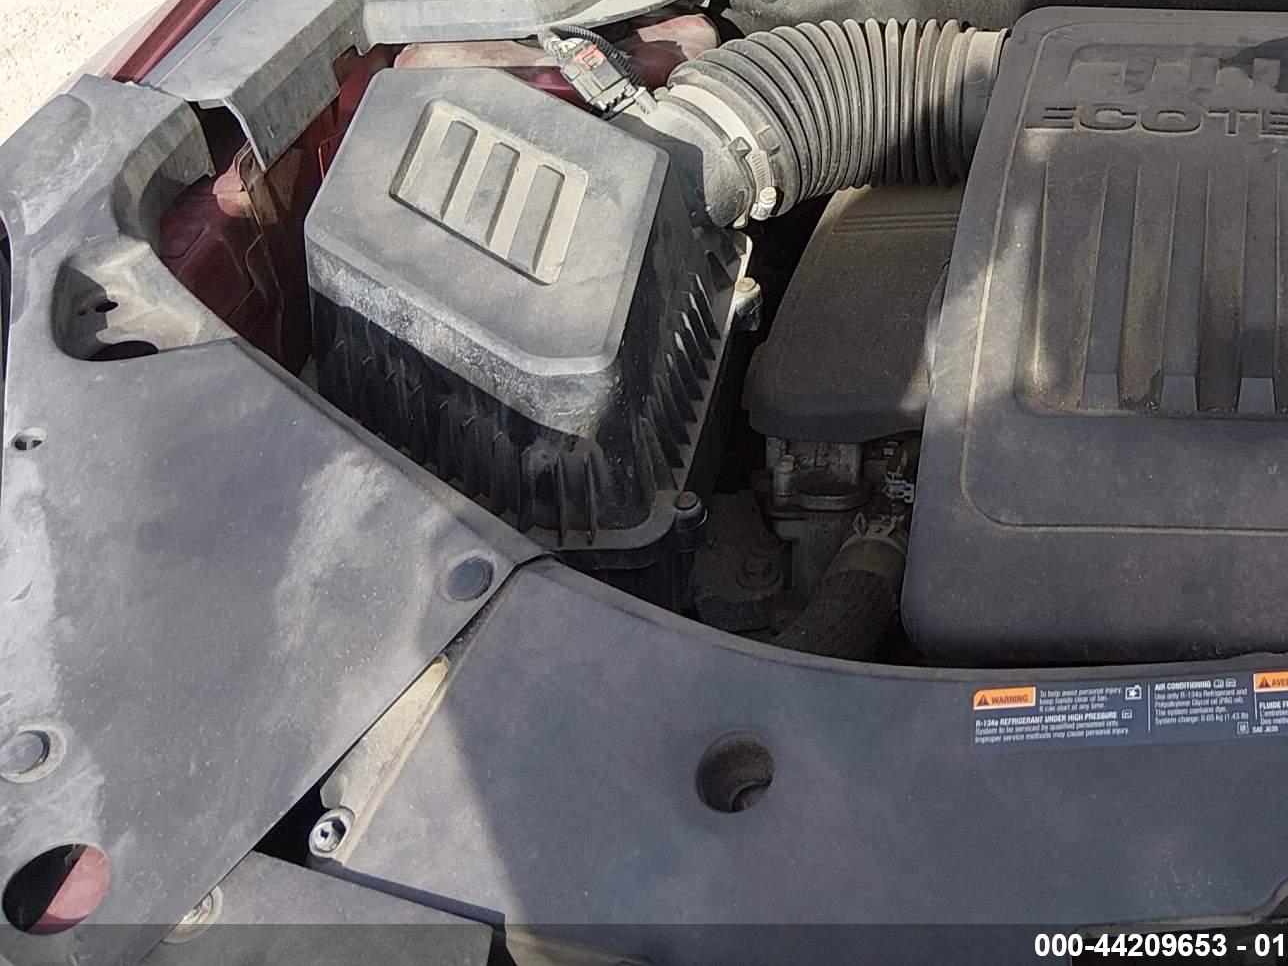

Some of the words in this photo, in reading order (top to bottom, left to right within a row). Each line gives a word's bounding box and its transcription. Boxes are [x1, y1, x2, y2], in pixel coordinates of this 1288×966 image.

[1167, 681, 1211, 690] CONDITIONING
[991, 695, 1029, 705] WARNING
[1260, 700, 1281, 710] FLUIDE
[976, 719, 998, 727] R-134a
[1000, 716, 1043, 724] REFRIGERANT
[1044, 714, 1066, 722] UNDER
[1068, 713, 1083, 721] HIGH
[1085, 711, 1117, 720] PRESSURE
